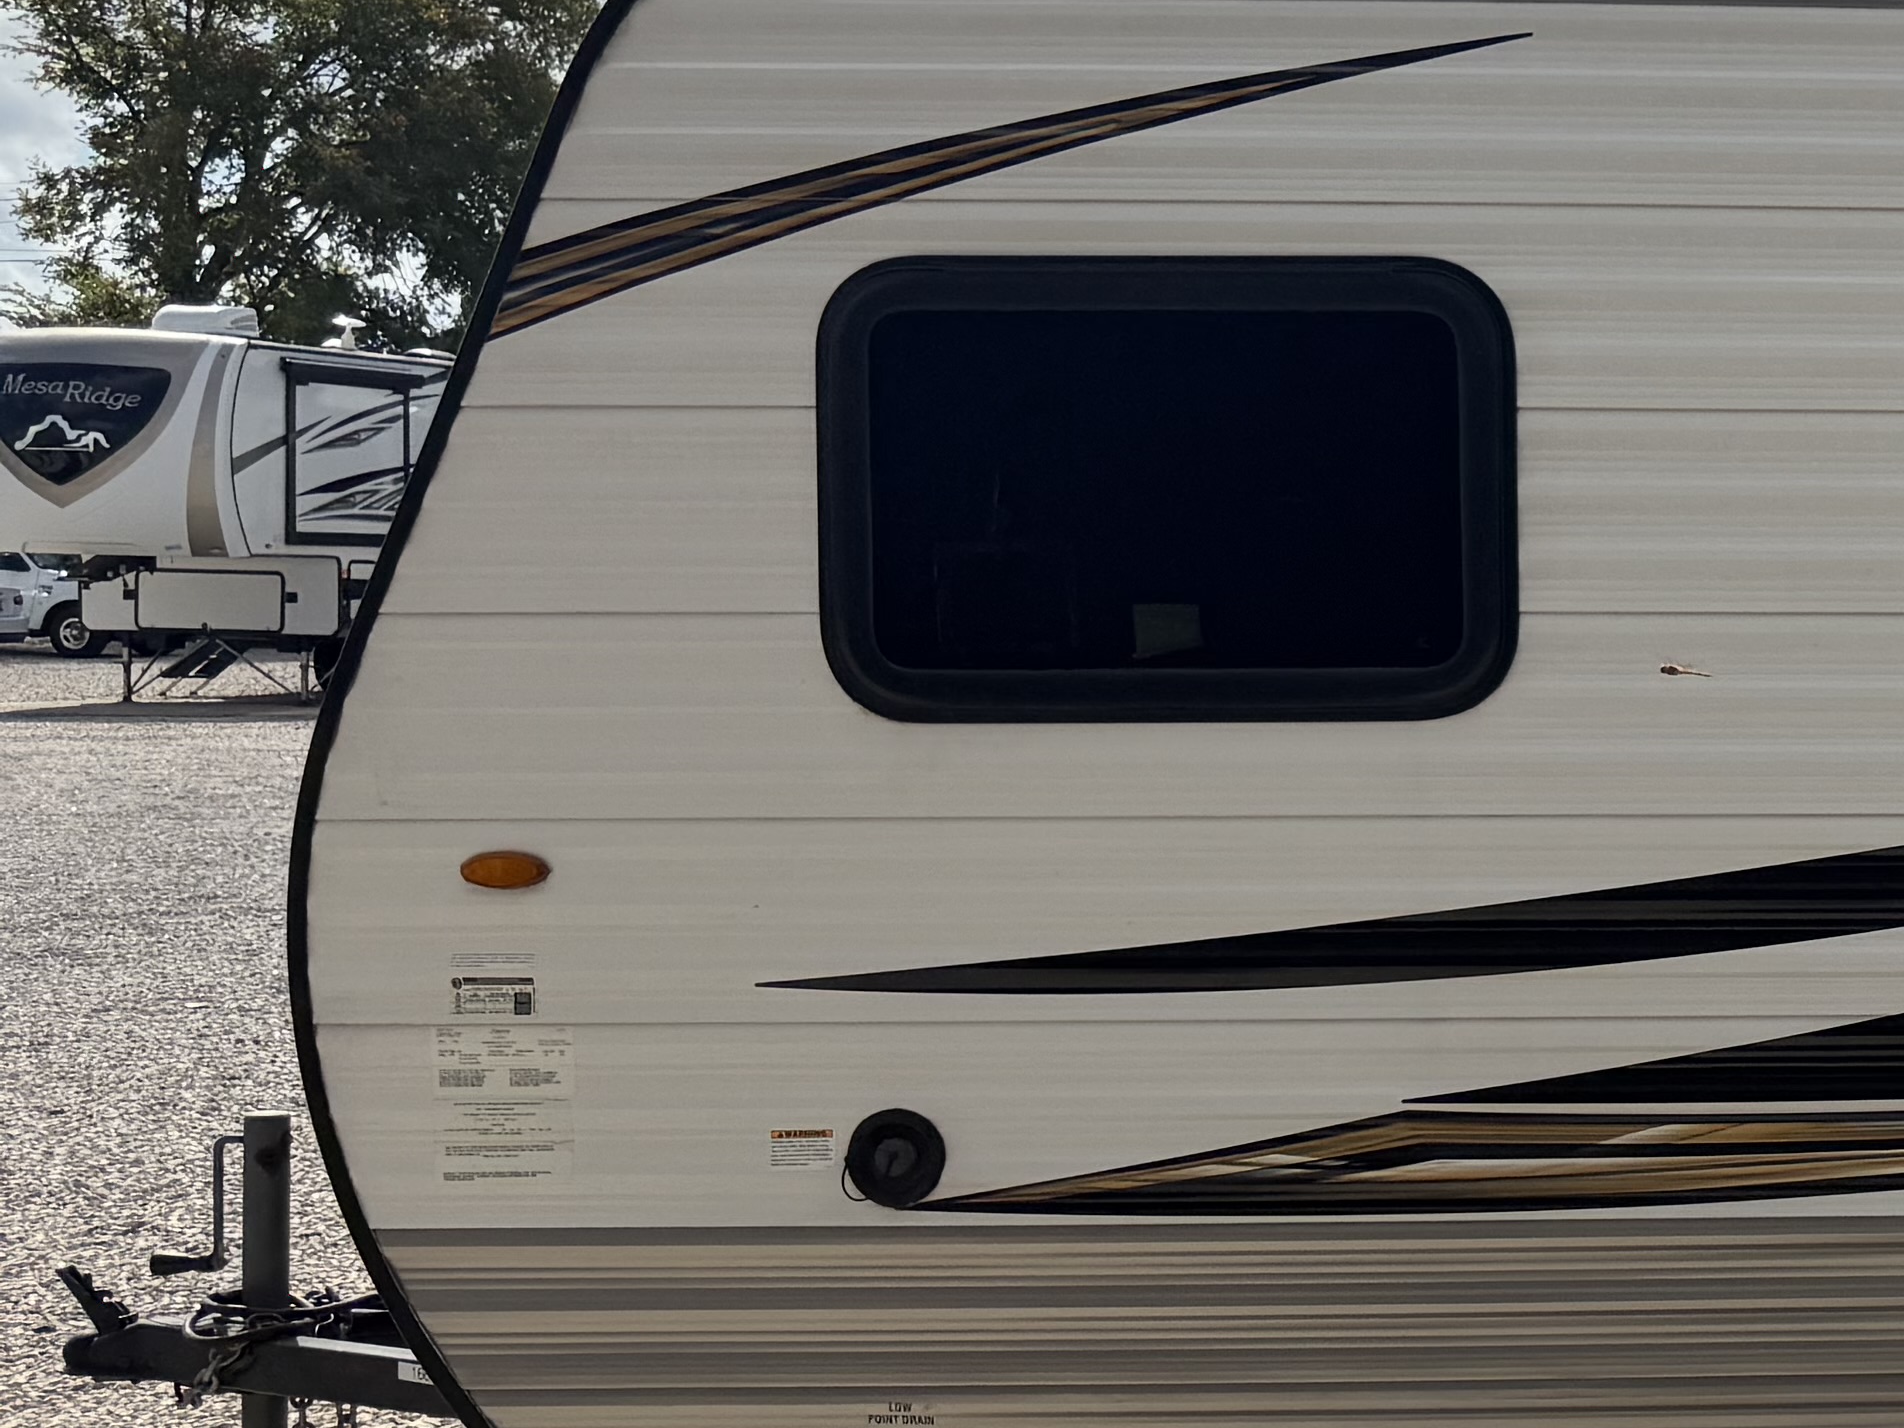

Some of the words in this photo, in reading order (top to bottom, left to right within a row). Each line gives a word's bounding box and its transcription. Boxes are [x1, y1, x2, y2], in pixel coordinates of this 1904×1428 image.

[888, 1401, 913, 1413] LOW
[868, 1414, 899, 1424] POINT
[901, 1414, 935, 1425] DRAIN
